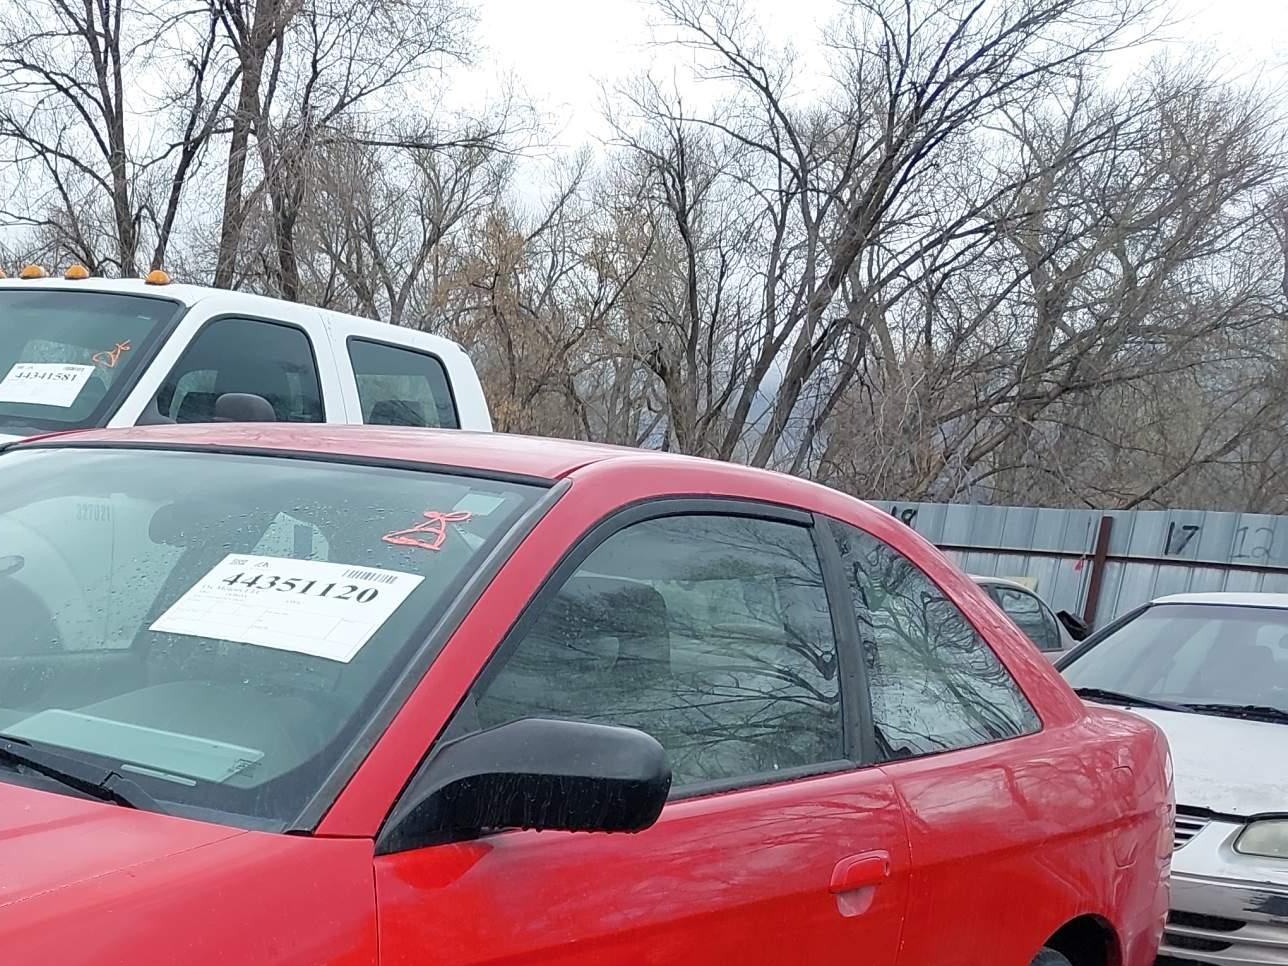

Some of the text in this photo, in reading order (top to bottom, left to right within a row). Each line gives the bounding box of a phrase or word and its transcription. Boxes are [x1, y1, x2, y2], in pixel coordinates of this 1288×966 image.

[14, 371, 78, 383] 44341581
[1164, 521, 1200, 556] 17
[1230, 526, 1274, 560] 12
[221, 572, 379, 604] 44351120
